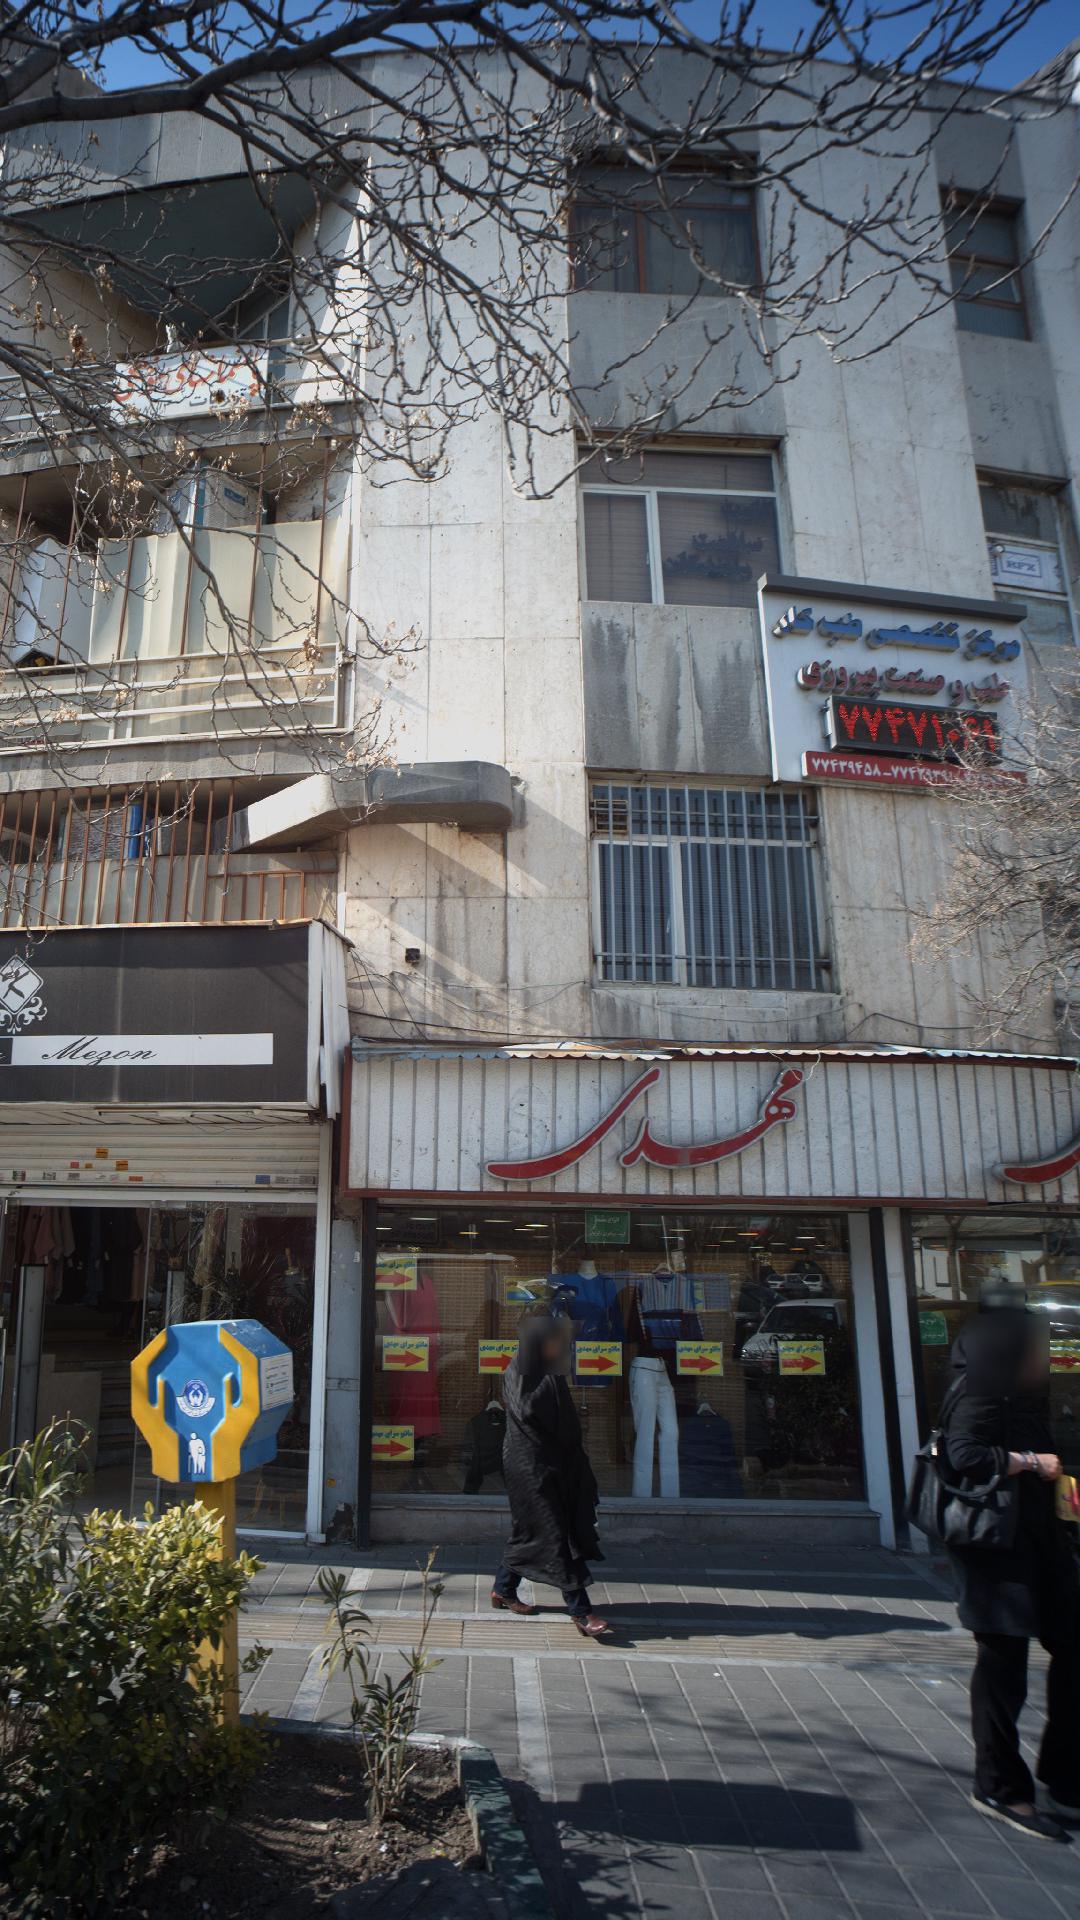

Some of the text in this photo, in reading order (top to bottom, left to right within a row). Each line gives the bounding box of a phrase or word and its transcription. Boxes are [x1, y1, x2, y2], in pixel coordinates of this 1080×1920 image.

[772, 606, 813, 639] کار
[963, 629, 1021, 663] مرکز
[796, 660, 881, 699] پیروزی
[881, 667, 945, 696] صنعت
[949, 680, 965, 707] و
[41, 1036, 159, 1067] Mezon
[484, 1066, 805, 1183] مهدی
